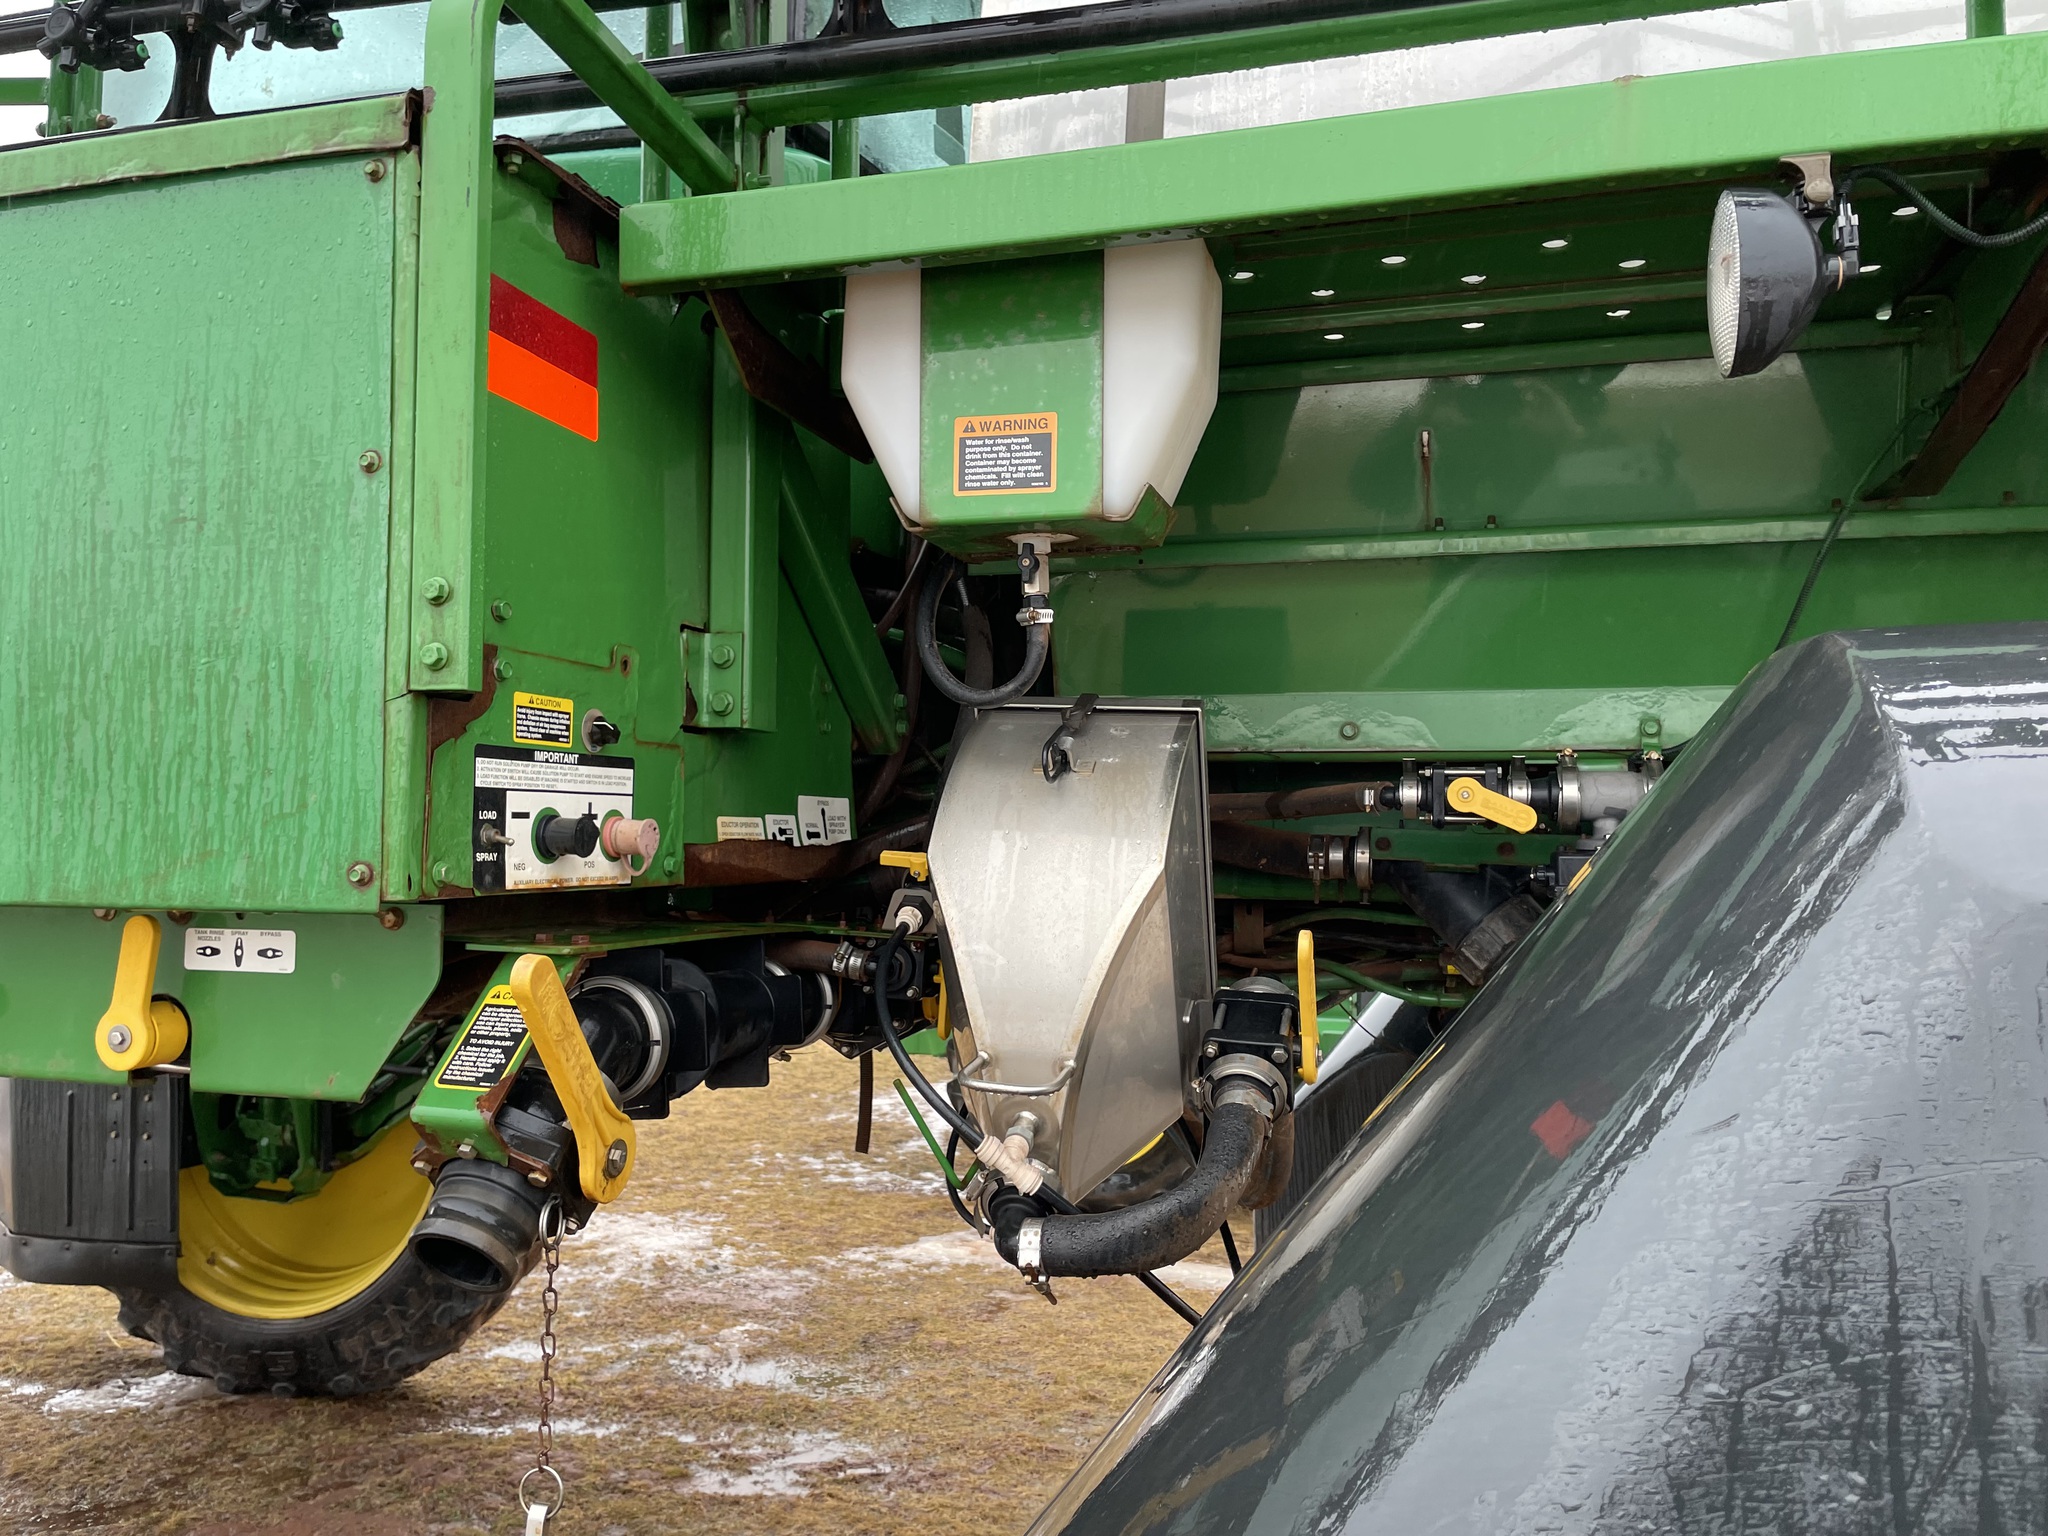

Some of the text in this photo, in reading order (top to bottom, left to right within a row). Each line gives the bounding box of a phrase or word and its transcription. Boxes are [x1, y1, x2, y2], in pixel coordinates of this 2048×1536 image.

[980, 418, 1048, 432] WARNING
[536, 698, 561, 708] CAUTION
[535, 750, 579, 764] IMPORTANT
[479, 811, 497, 820] LOAD
[476, 853, 497, 862] SPRAY
